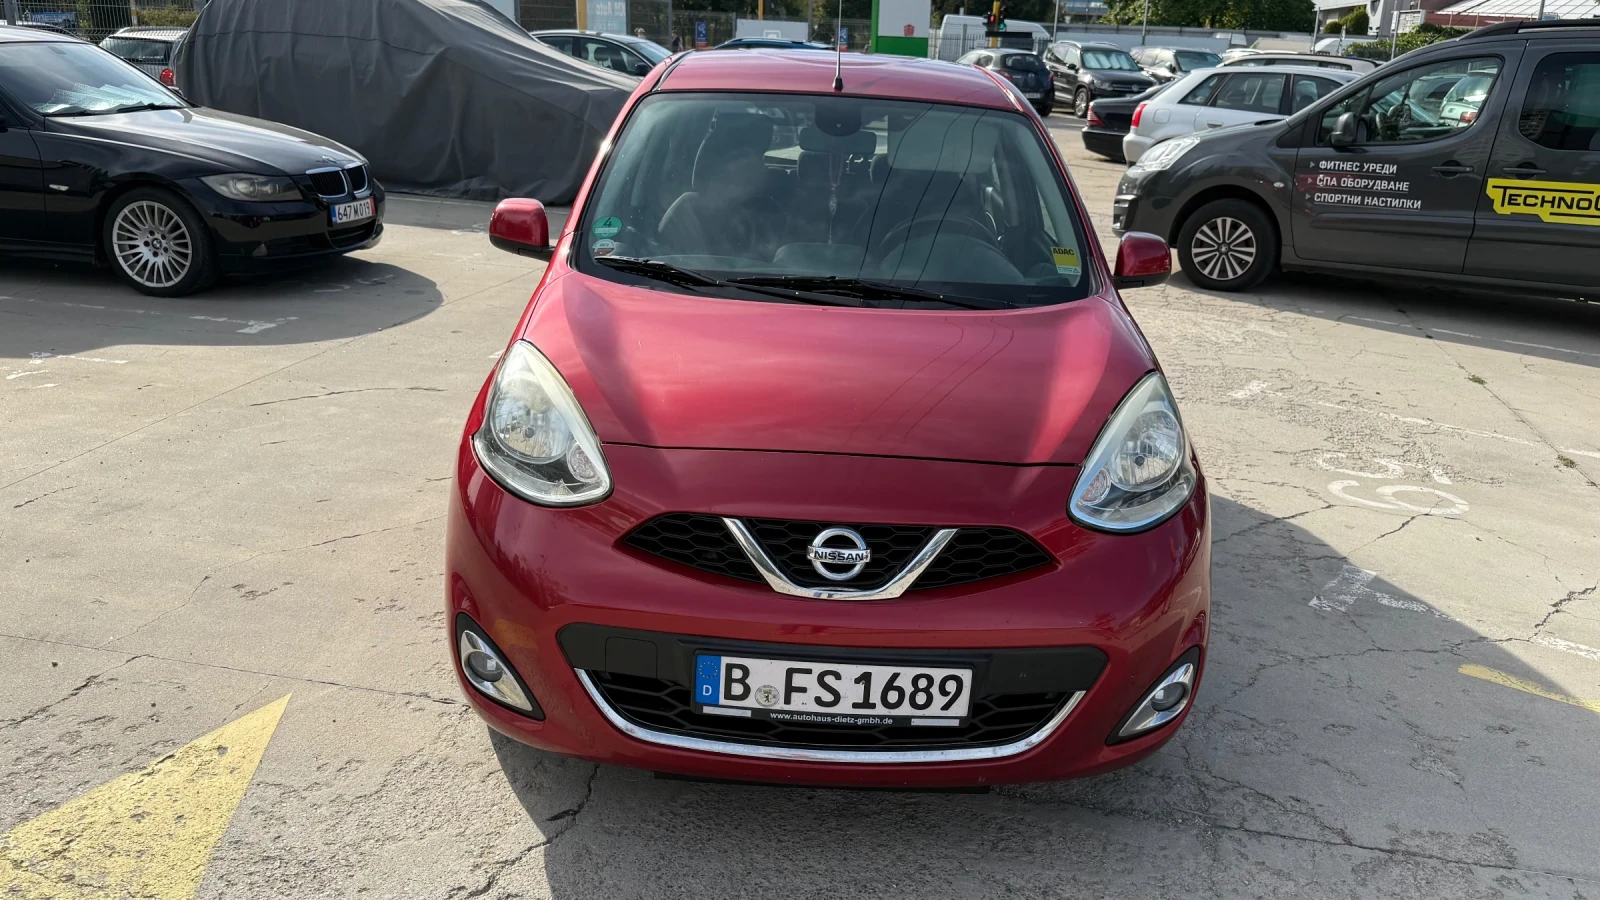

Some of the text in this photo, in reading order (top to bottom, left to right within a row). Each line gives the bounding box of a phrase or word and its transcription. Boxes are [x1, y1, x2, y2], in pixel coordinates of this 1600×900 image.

[1319, 160, 1398, 175] ФИТНЕС УРЕДИ
[1316, 175, 1409, 191] СПА ОБОРУДВАНЕ
[1314, 192, 1422, 210] СПОРТНИ НАСТИЛКИ
[603, 217, 612, 227] 4
[1053, 247, 1075, 256] ADAC
[814, 550, 864, 562] NISSAN
[724, 662, 751, 701] B
[702, 684, 712, 696] D
[770, 711, 893, 726] www.autohaus-dietz-gmbh.de
